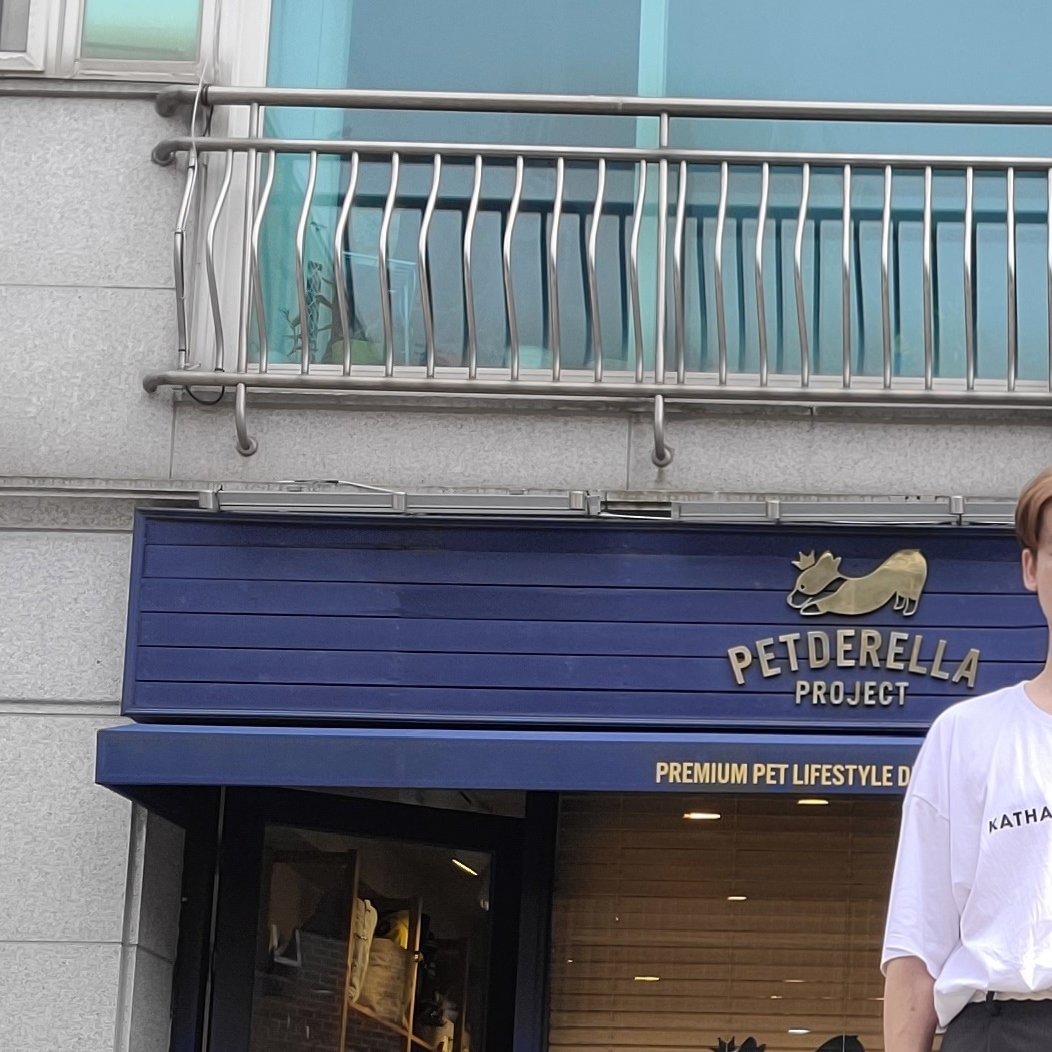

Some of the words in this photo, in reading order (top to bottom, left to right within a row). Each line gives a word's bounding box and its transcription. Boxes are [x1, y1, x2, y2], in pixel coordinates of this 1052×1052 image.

[727, 629, 980, 688] PETDERELLA
[795, 680, 909, 706] PROJECT
[656, 762, 748, 785] PREMIUM
[752, 763, 789, 785] PET
[792, 764, 894, 787] LIFESTYLE
